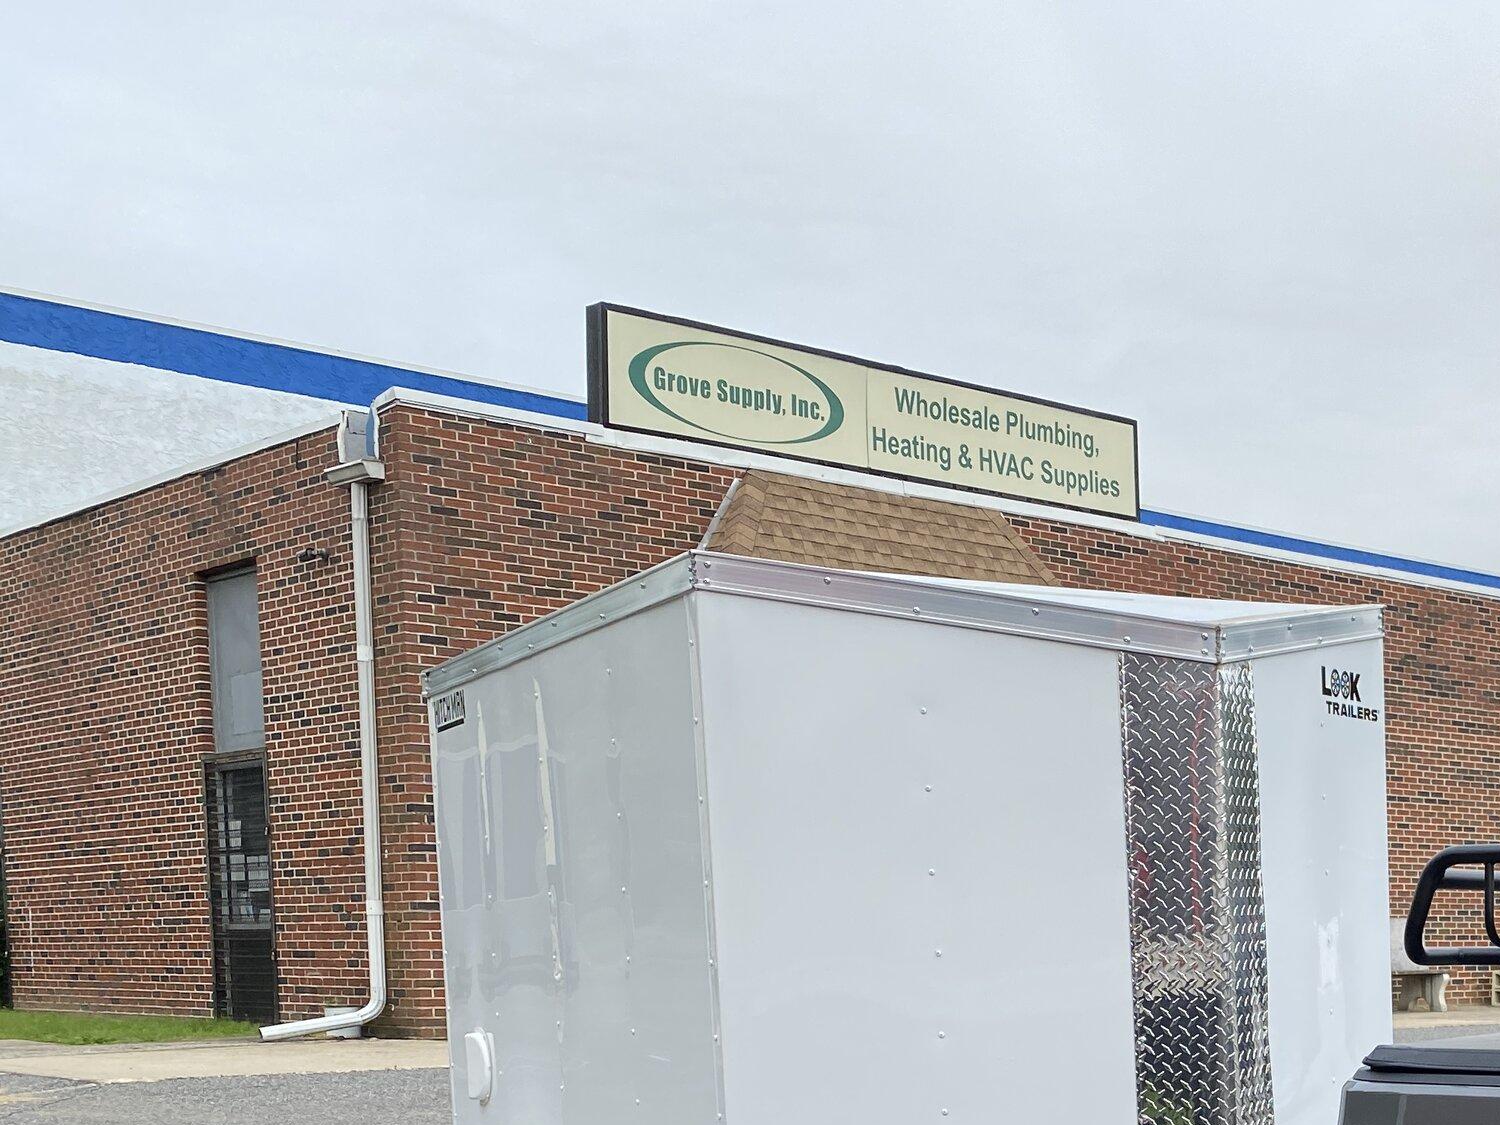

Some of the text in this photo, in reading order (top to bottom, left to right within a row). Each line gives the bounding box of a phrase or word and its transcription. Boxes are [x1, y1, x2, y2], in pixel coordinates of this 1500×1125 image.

[653, 366, 825, 421] Grove Supply, Inc.
[894, 386, 1099, 458] Wholesale Plumbing,
[872, 426, 1120, 497] Heating & HVAC Supplies
[1321, 665, 1361, 702] LOOK
[1326, 700, 1378, 721] TRAILERS
